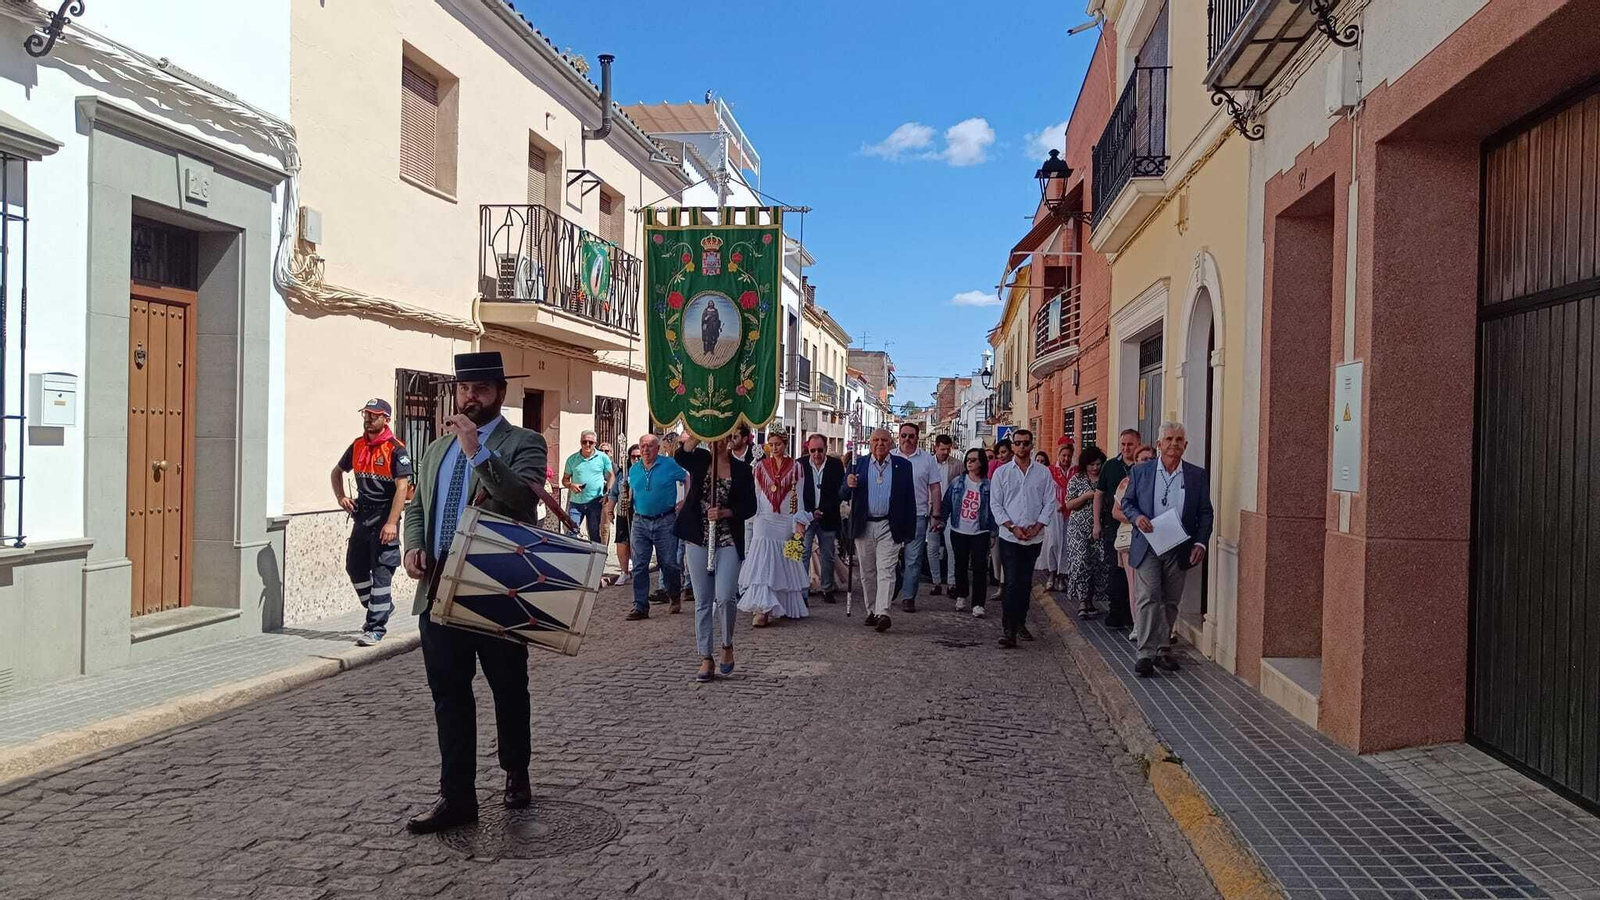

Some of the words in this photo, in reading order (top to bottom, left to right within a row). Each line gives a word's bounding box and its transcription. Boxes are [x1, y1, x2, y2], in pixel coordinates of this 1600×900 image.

[190, 174, 212, 198] 26
[966, 489, 979, 501] BI
[961, 508, 977, 520] US
